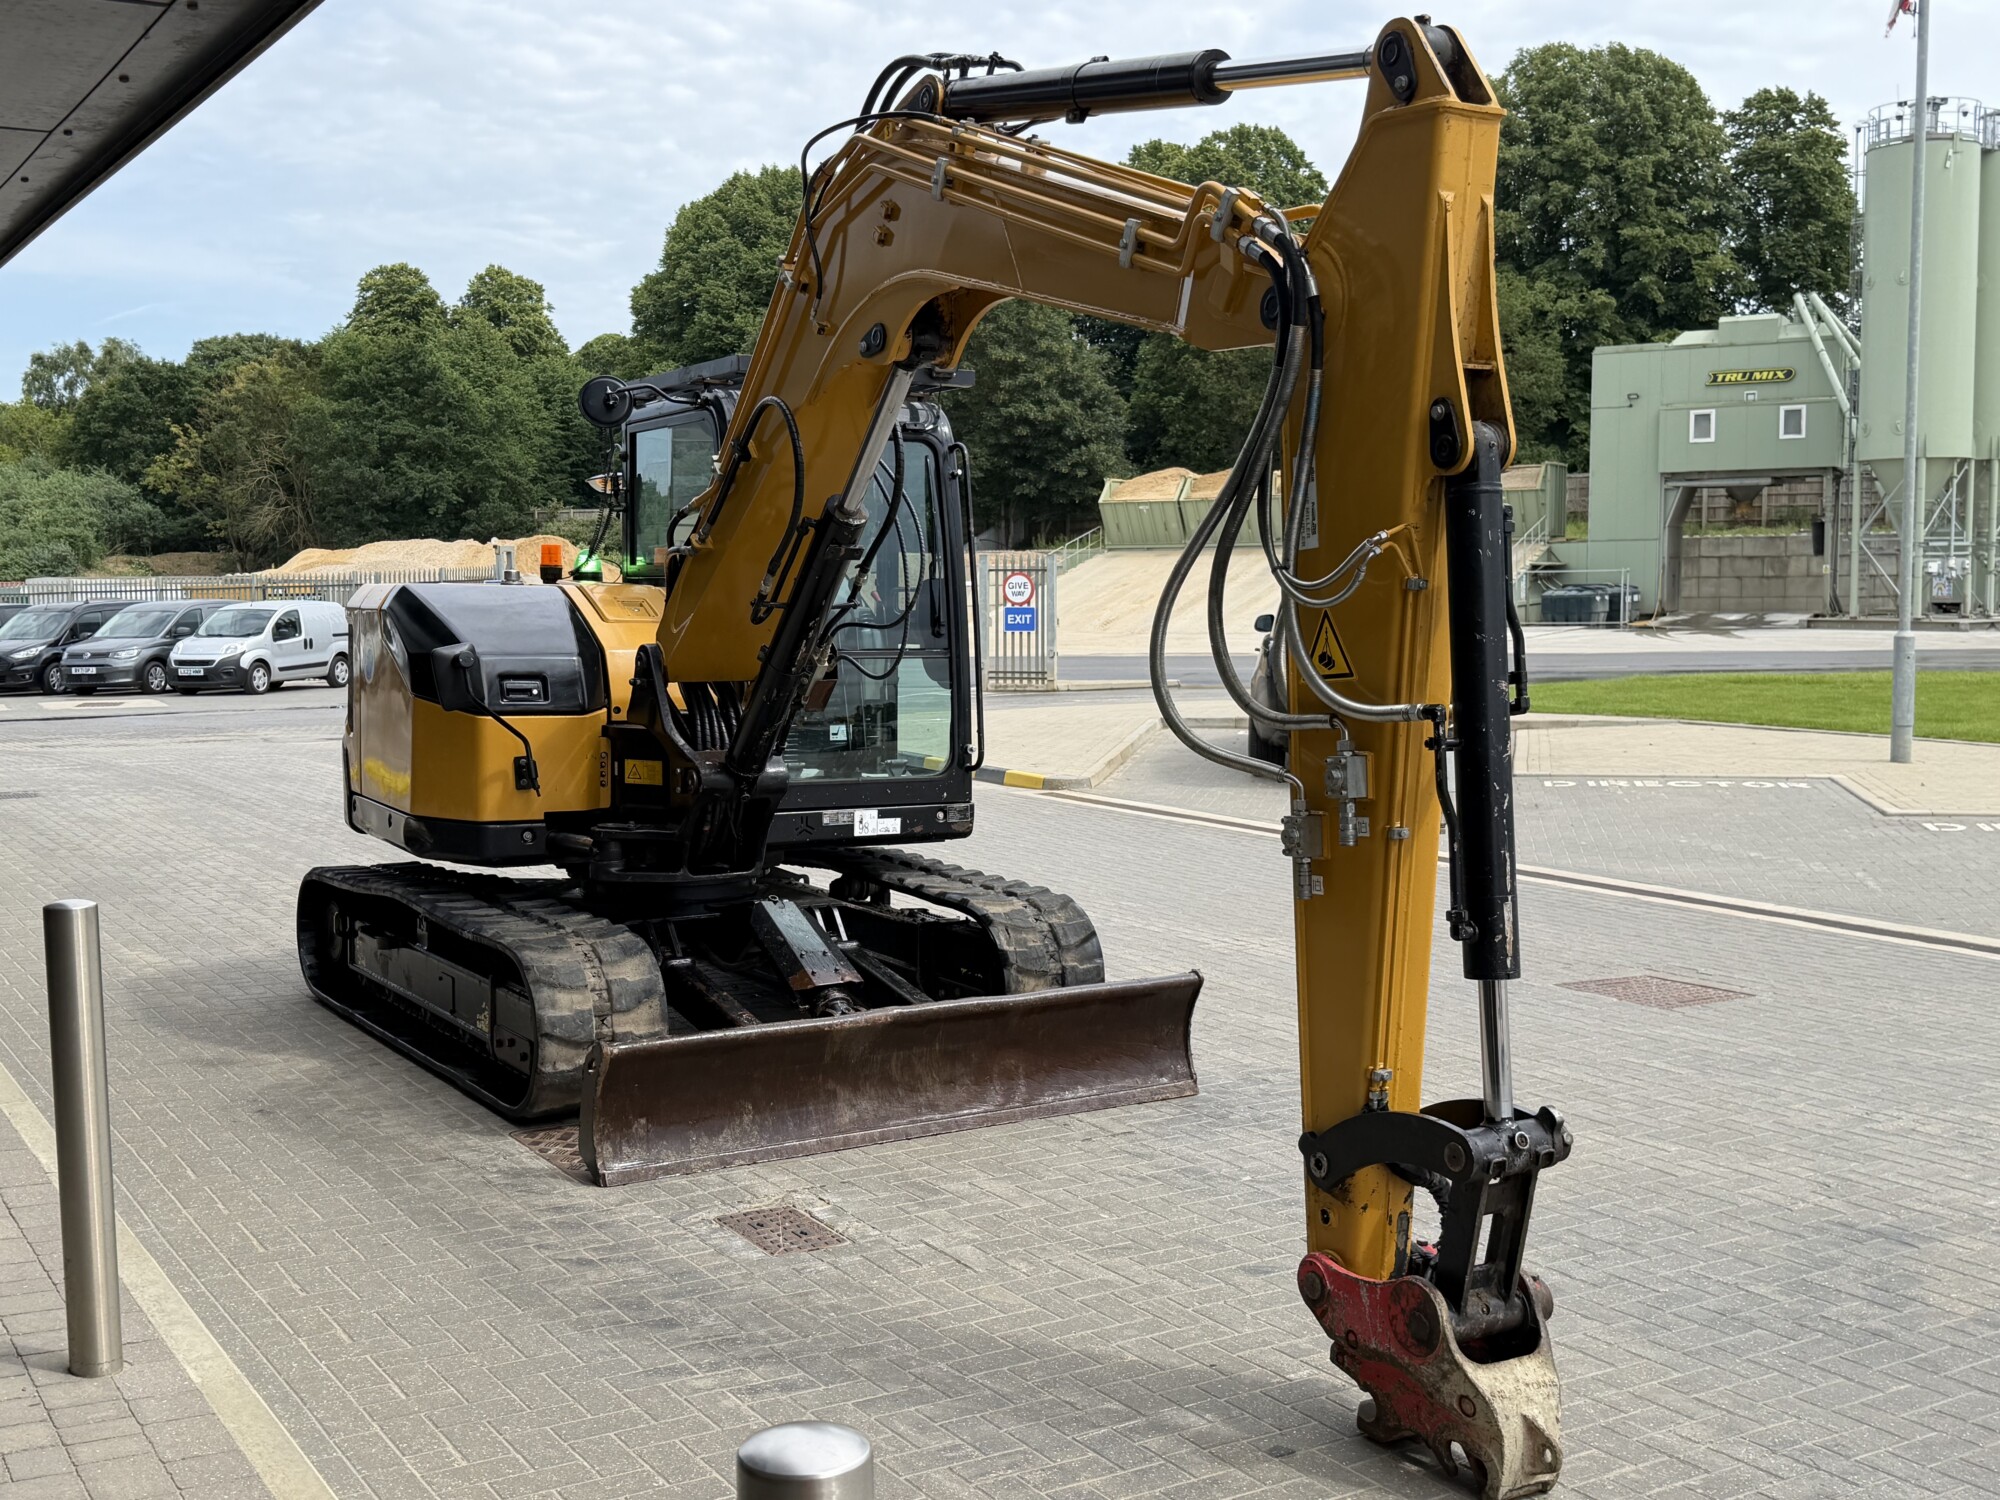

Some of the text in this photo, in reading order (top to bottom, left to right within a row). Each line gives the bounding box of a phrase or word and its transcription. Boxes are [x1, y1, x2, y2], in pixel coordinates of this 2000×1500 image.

[1715, 370, 1788, 382] TRU MIX
[1008, 582, 1029, 590] GIVE
[1007, 614, 1032, 624] EXIT
[1544, 780, 1811, 789] DIRECTOR
